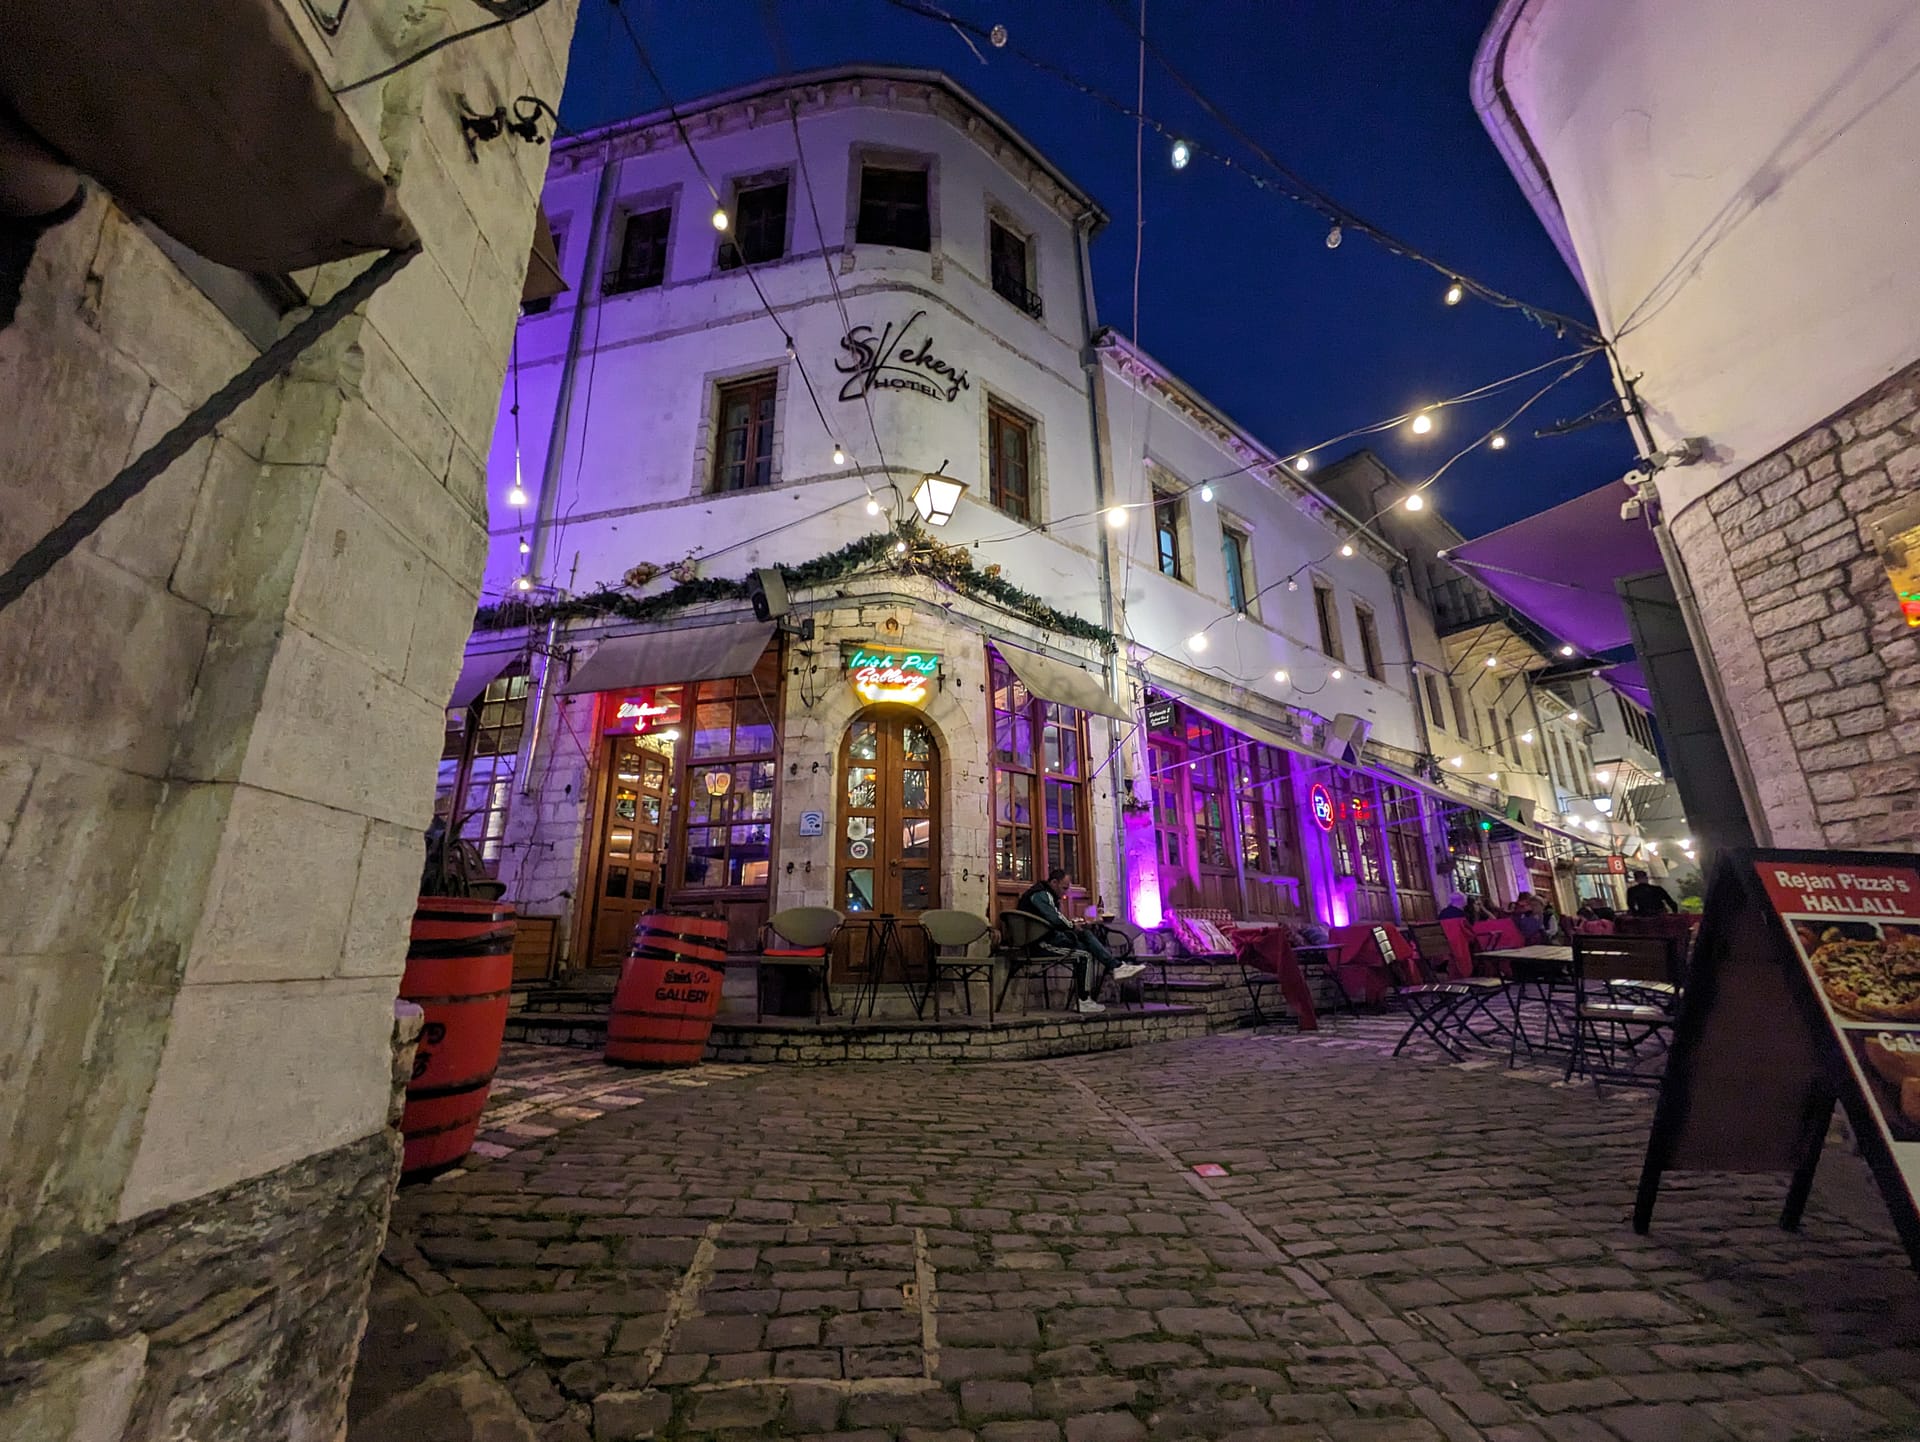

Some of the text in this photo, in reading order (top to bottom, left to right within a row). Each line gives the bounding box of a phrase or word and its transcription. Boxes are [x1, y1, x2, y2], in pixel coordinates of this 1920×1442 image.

[874, 378, 943, 401] HOTEL
[850, 651, 938, 672] Irish Pub
[855, 667, 928, 691] Gallery
[1614, 860, 1623, 871] 8
[1774, 870, 1911, 893] Rejan Pizza's
[1801, 895, 1905, 915] HALLALL
[655, 987, 710, 1003] GALLERY
